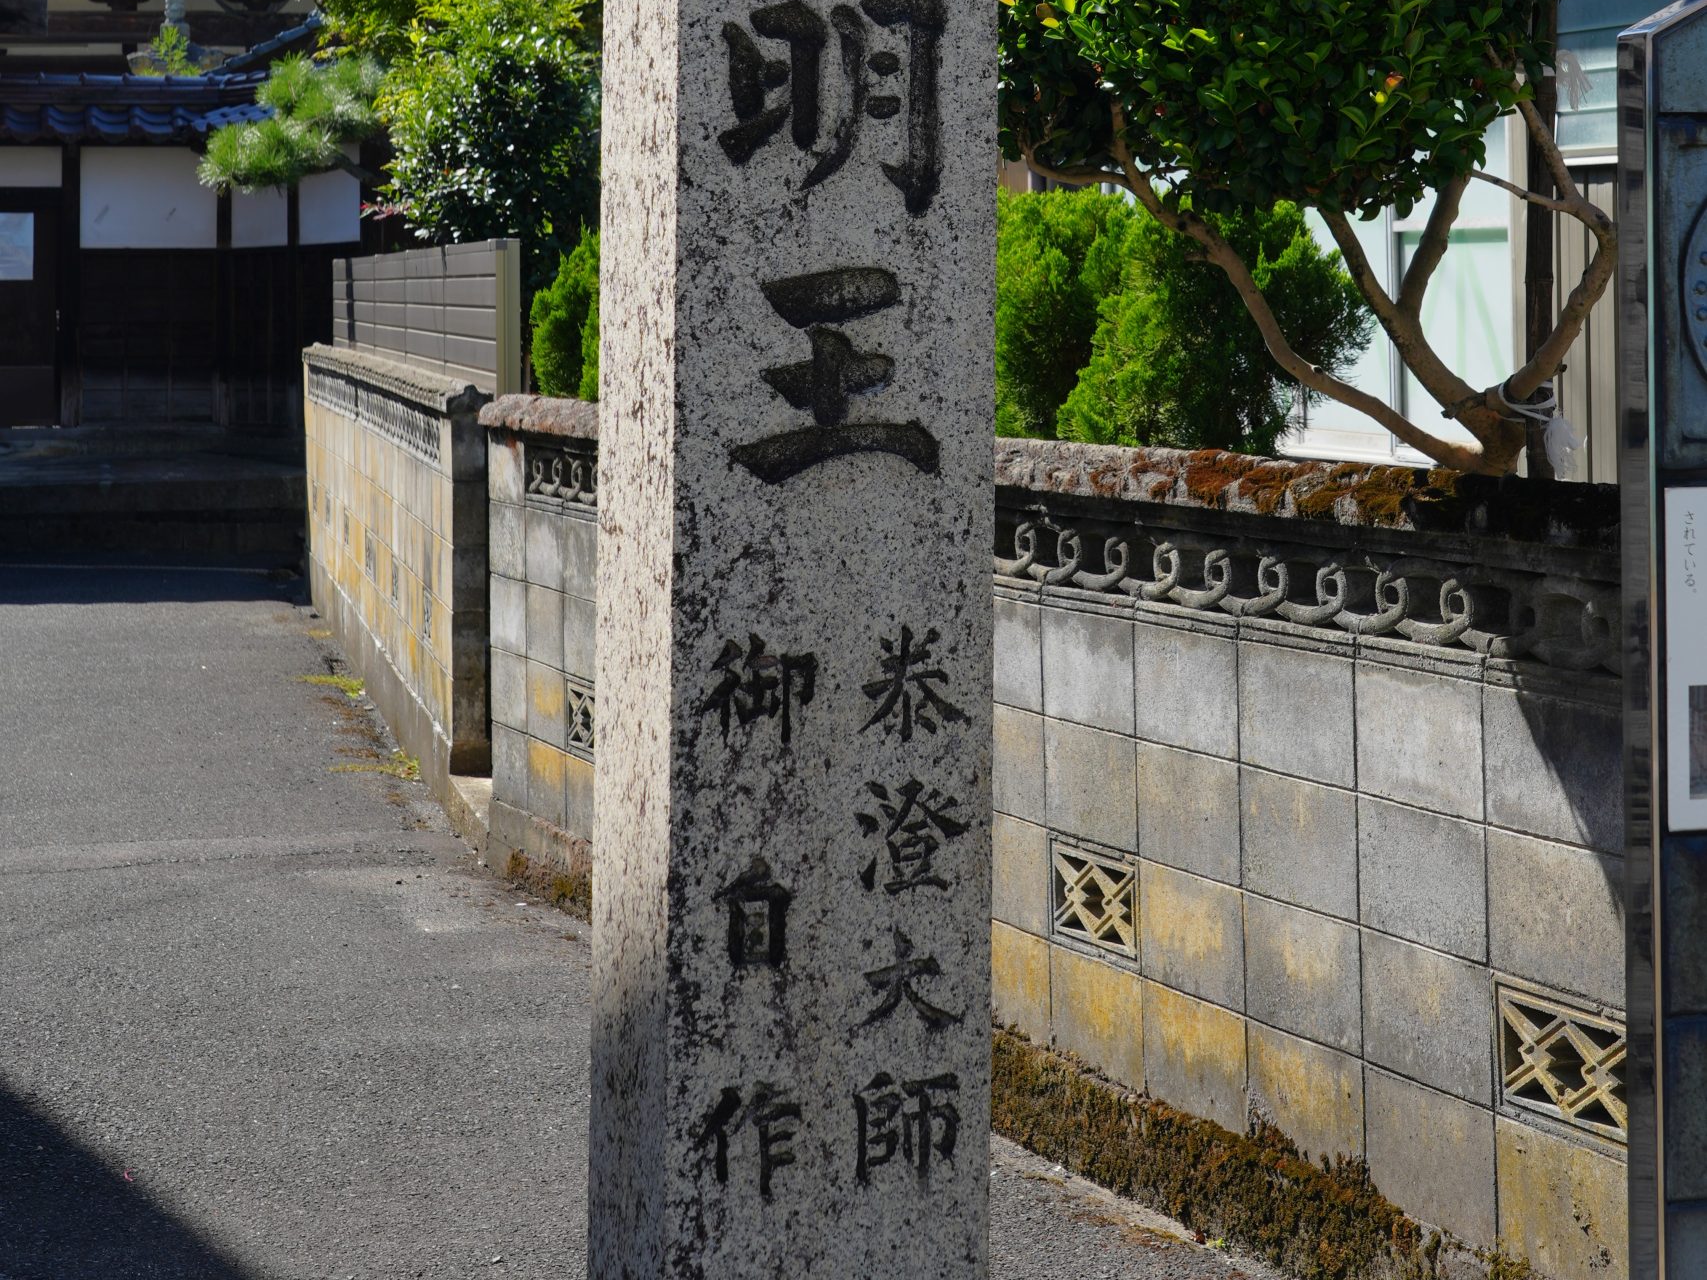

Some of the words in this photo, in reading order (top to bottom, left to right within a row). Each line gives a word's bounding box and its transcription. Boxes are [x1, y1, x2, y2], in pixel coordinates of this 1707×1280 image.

[1683, 510, 1698, 594] されている。
[703, 631, 819, 1200] 御自作
[856, 624, 972, 1188] 泰澄大師
